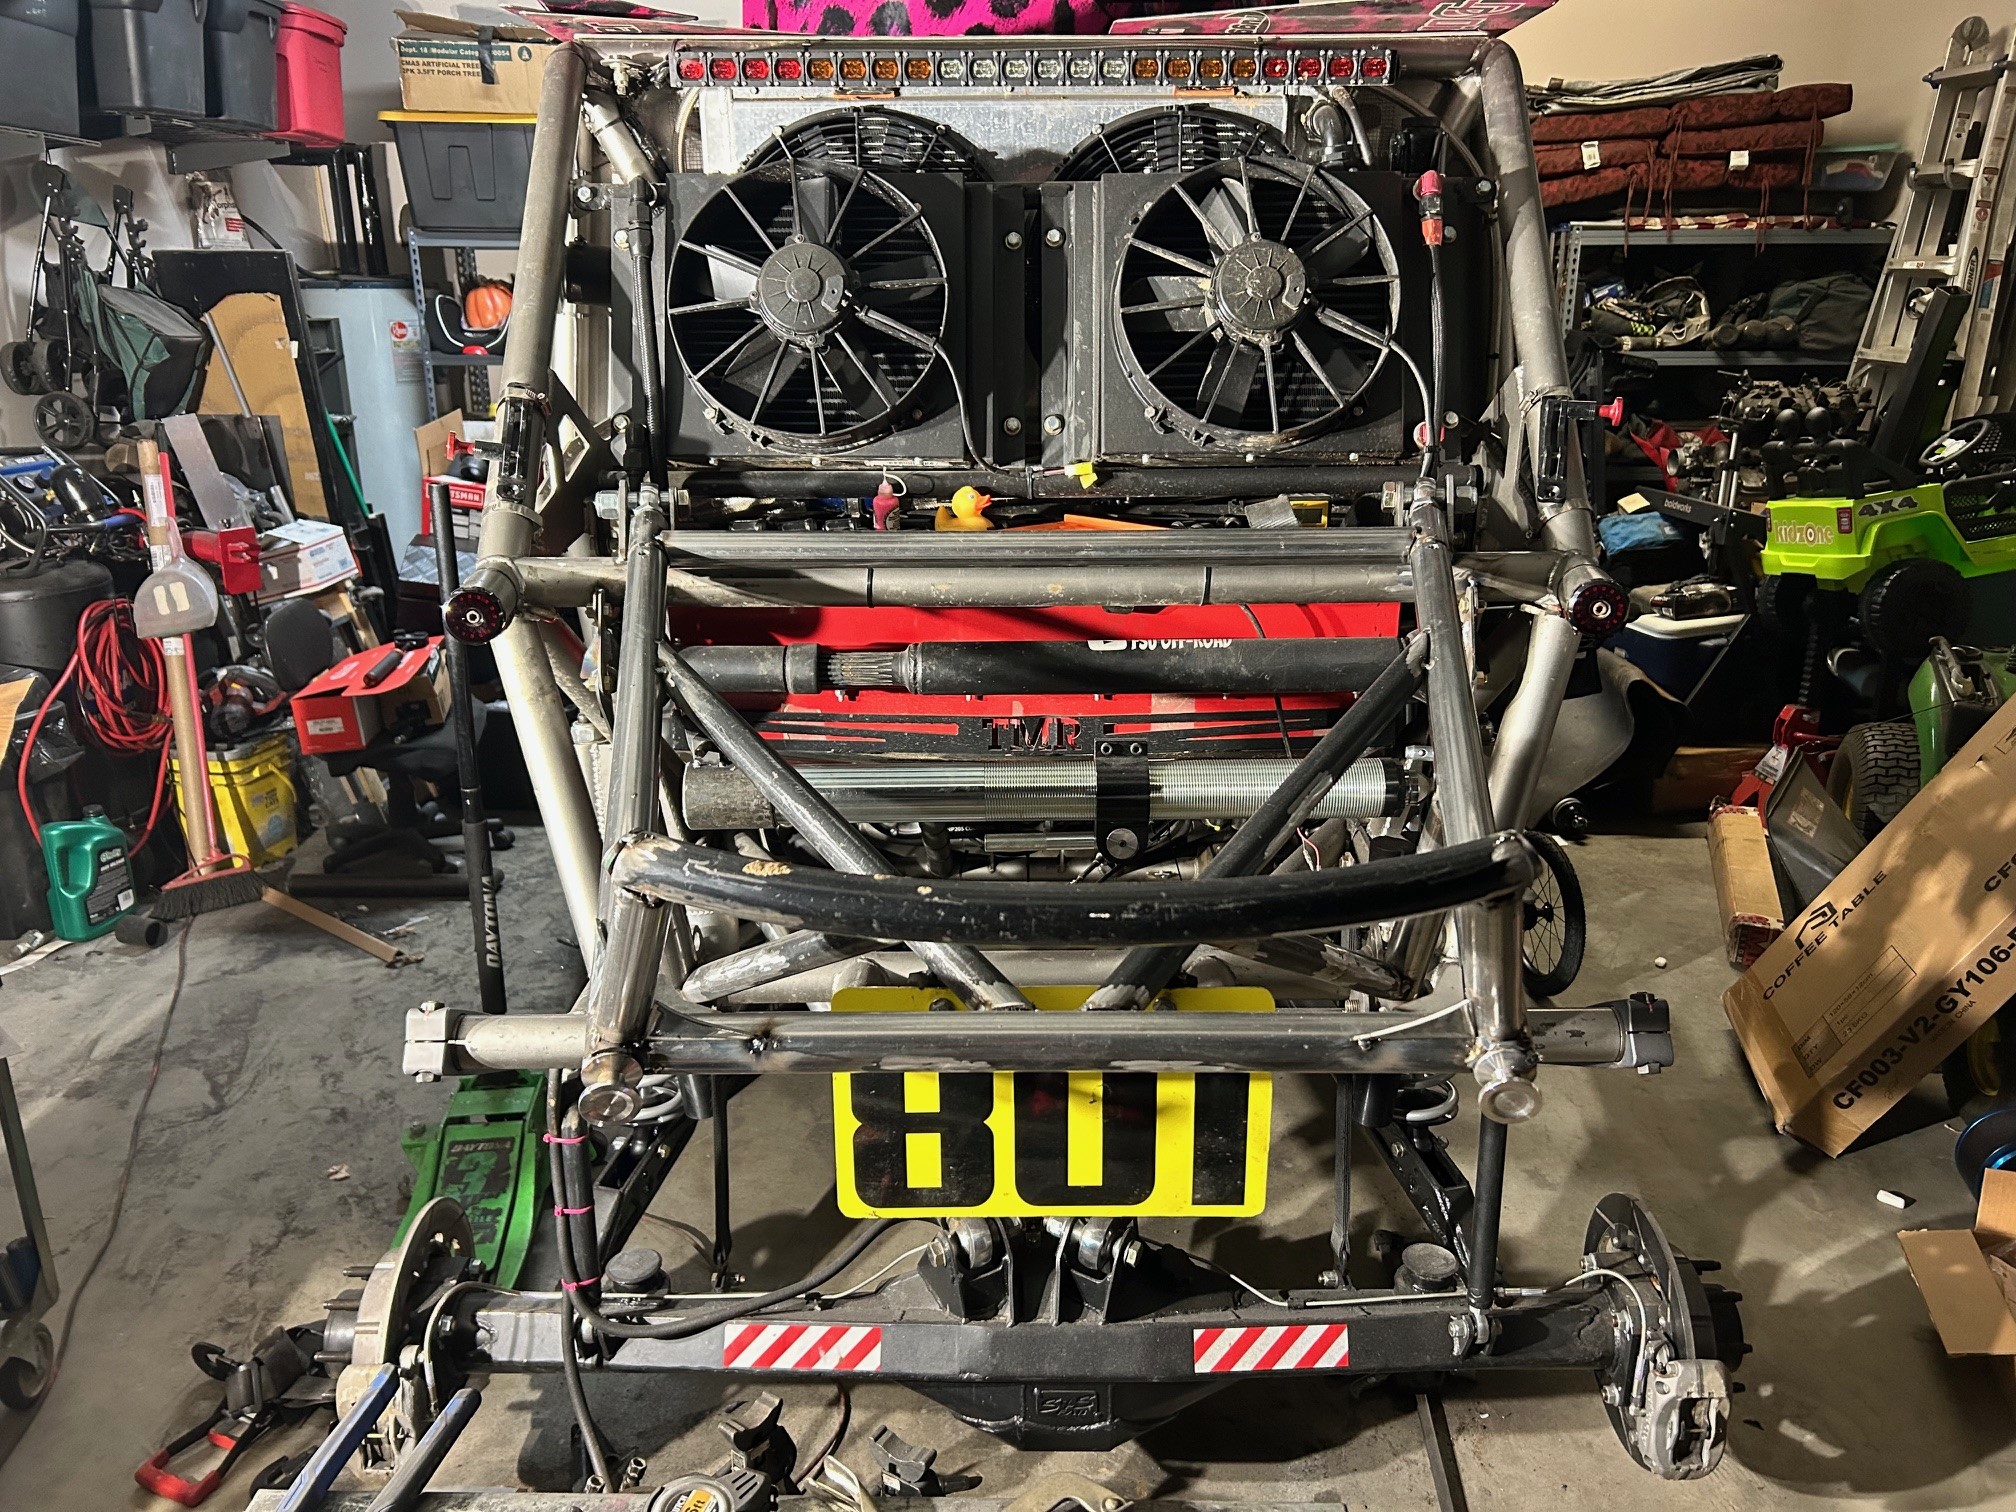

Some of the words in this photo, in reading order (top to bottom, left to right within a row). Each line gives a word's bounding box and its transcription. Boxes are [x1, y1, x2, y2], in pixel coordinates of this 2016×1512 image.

[422, 61, 460, 69] ARTIFICIAL
[1966, 259, 1977, 292] ERNER
[981, 717, 1082, 752] TMR
[481, 875, 500, 968] DAYTONA
[1762, 931, 1828, 1001] COFFEE
[1828, 870, 1888, 927] TABLE
[1954, 999, 1977, 1020] CHINA
